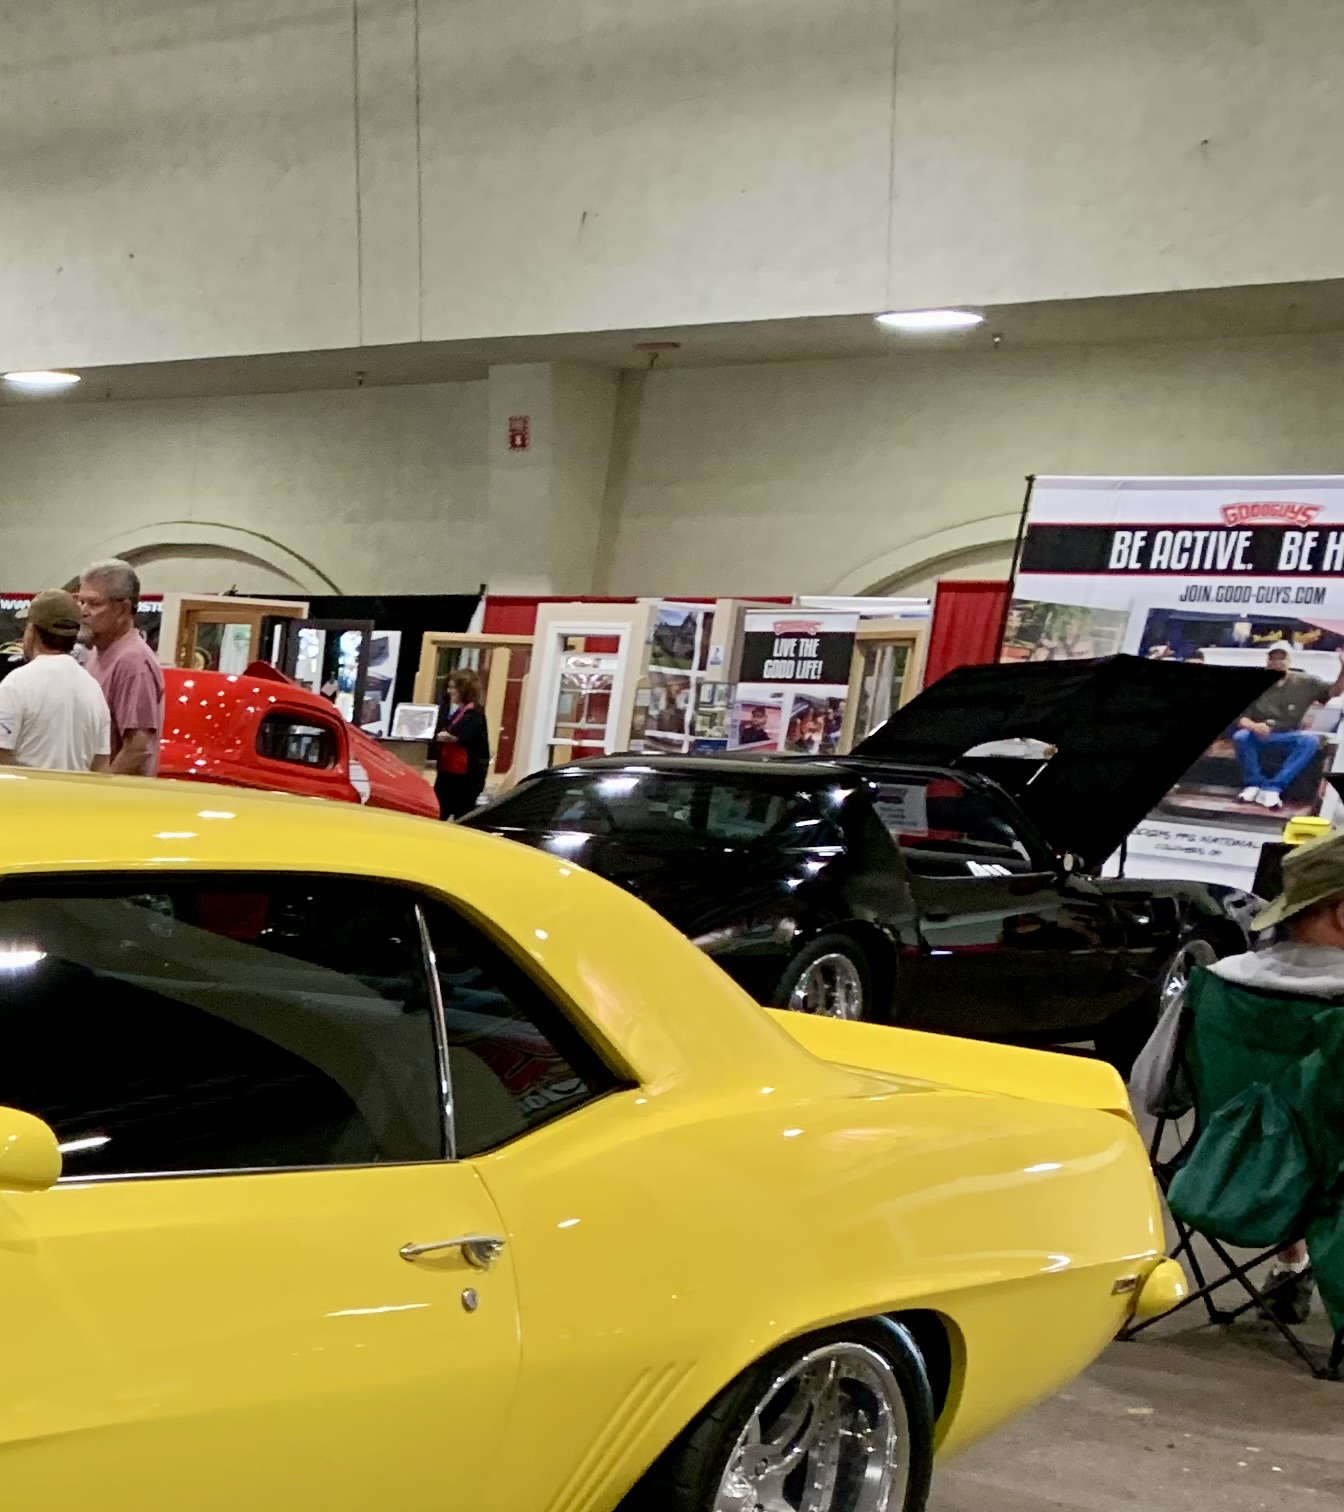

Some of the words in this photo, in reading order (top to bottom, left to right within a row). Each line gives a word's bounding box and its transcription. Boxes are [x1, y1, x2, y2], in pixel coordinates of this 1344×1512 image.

[1109, 530, 1148, 570] BE
[1150, 530, 1254, 570] ACTIVE.
[1278, 530, 1320, 571] BE
[773, 638, 797, 657] LIVE
[799, 638, 820, 658] THE
[763, 659, 796, 680] GOOD
[796, 659, 823, 680] LIFE!
